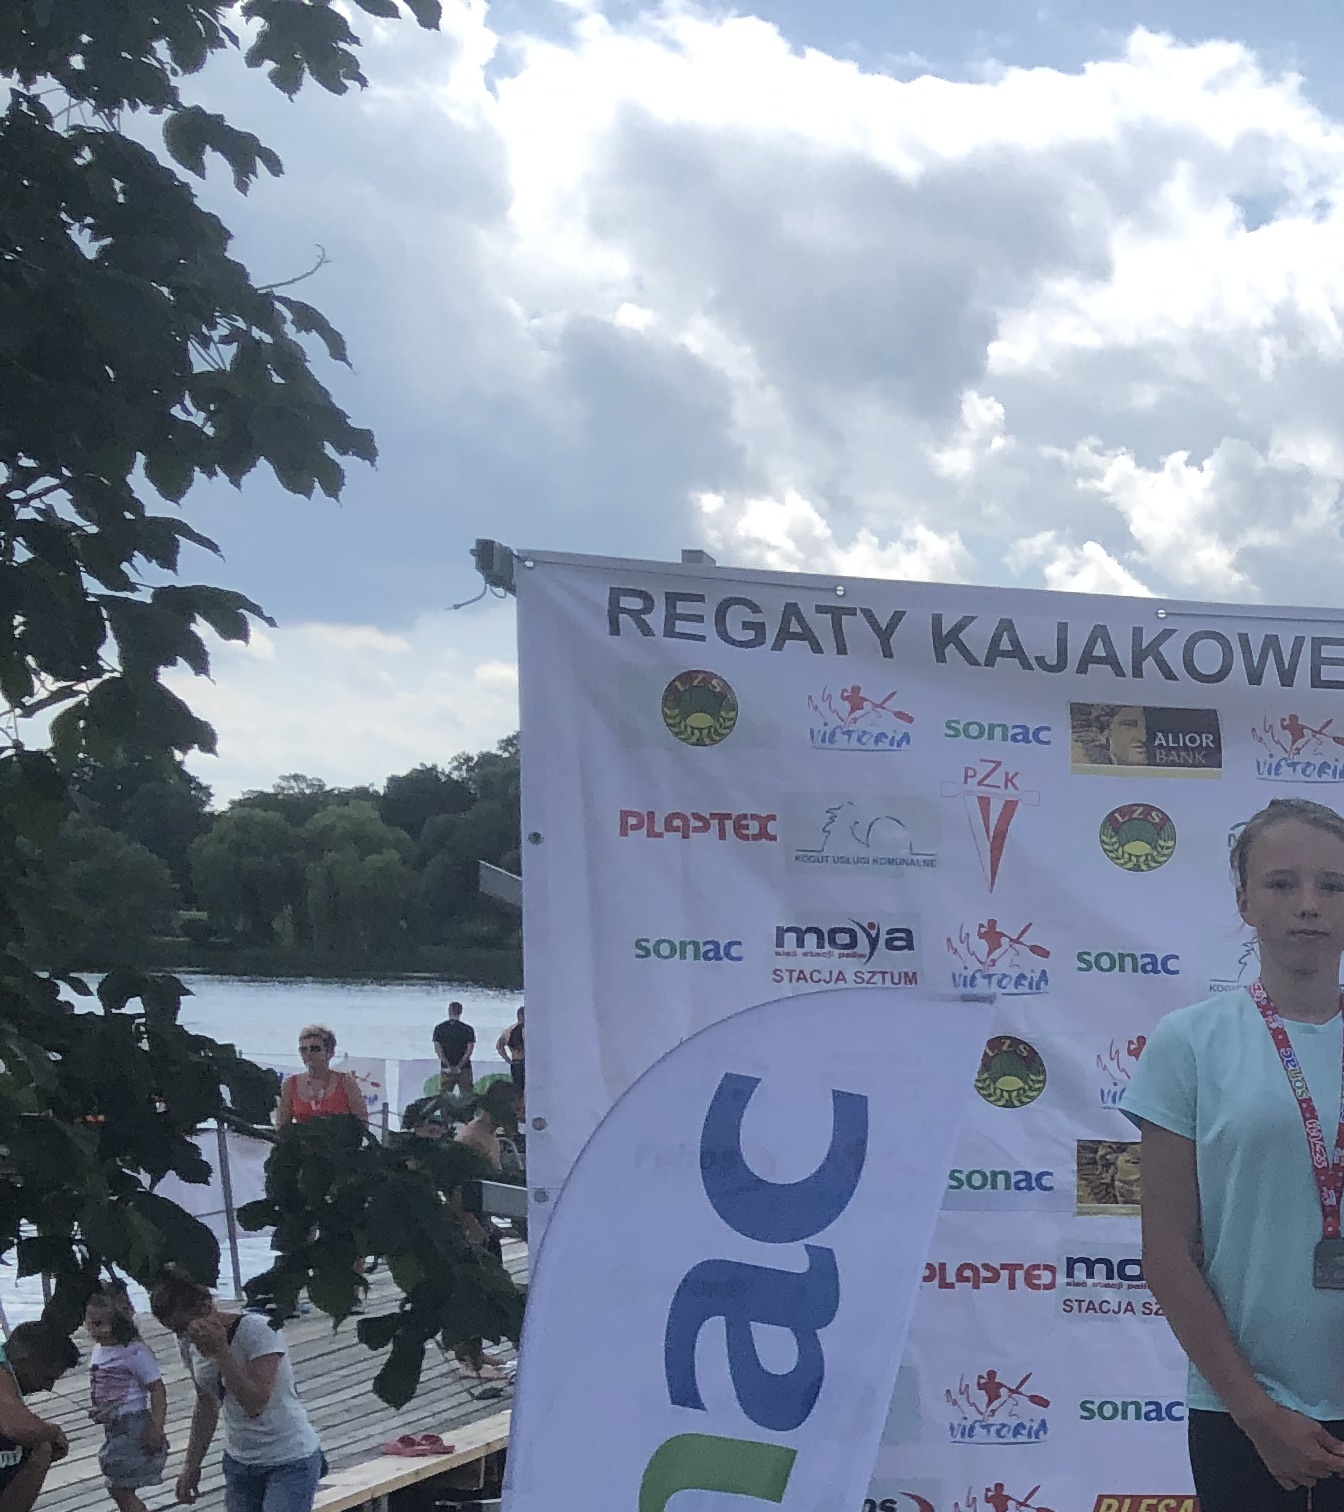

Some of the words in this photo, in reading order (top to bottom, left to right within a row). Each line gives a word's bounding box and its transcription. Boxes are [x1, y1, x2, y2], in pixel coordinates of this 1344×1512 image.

[607, 586, 907, 660] REGATY
[944, 718, 1052, 747] sonac
[1154, 731, 1215, 749] ALIOR
[1155, 749, 1207, 766] BANK
[962, 758, 1021, 791] PZK
[795, 854, 830, 865] KOGUT
[871, 857, 937, 868] KOMUNALNE
[634, 937, 744, 962] sonac
[774, 916, 915, 965] moya
[1076, 950, 1181, 976] sonac
[772, 968, 848, 985] STACJA
[853, 970, 919, 986] SZTUM
[948, 1168, 1055, 1192] sonac
[1062, 1298, 1137, 1316] STACJA
[1080, 1399, 1185, 1422] sonac
